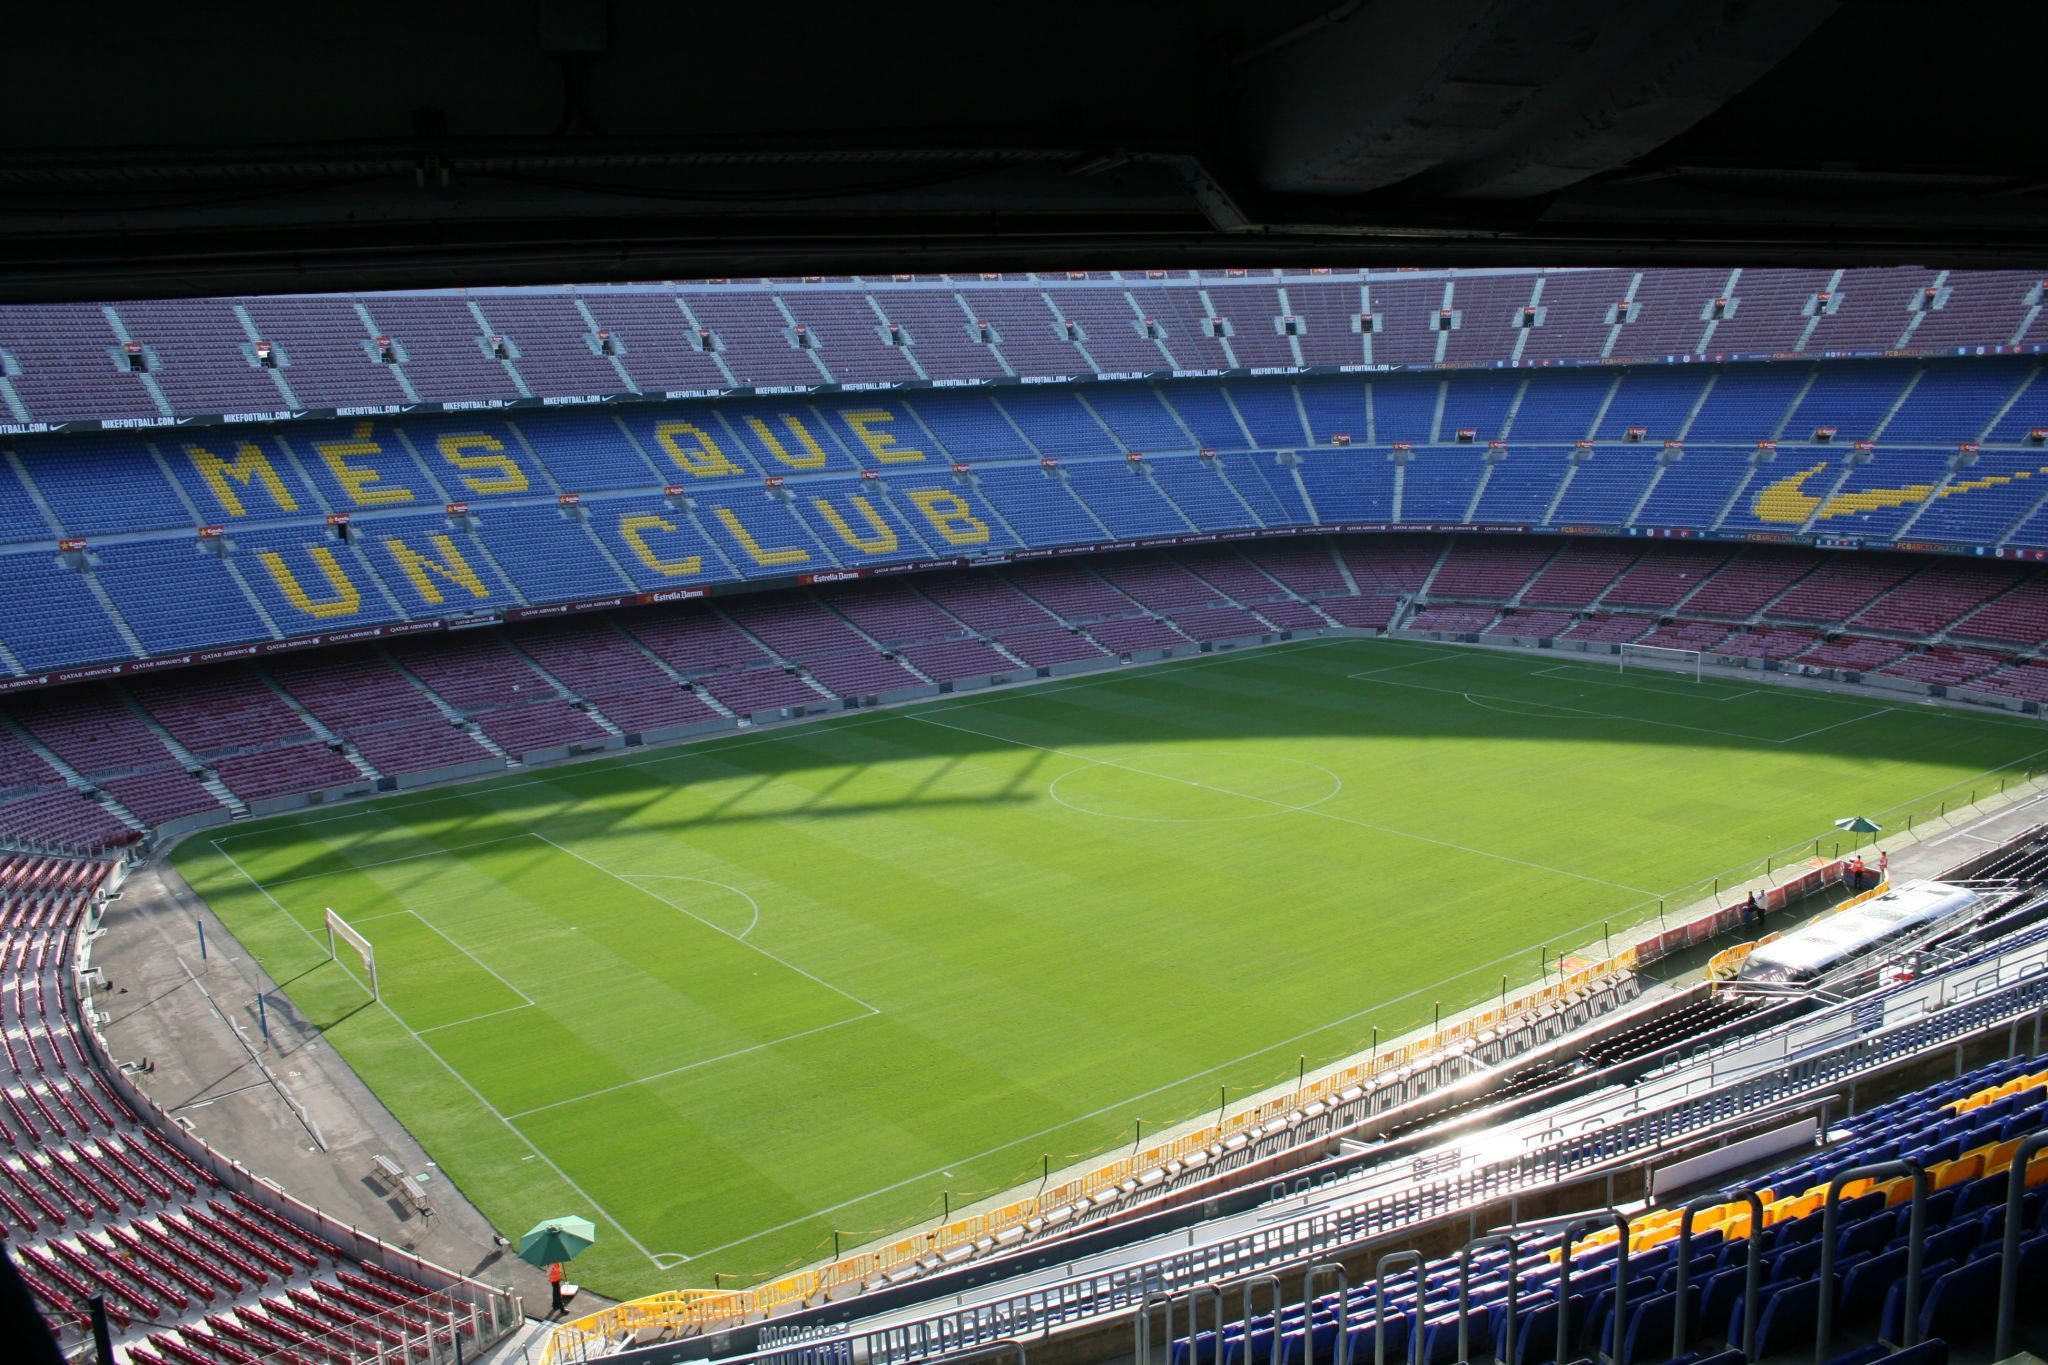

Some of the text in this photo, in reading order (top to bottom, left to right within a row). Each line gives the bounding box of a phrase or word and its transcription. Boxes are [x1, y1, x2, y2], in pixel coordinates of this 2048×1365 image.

[1172, 369, 1218, 378] NIKEFOOTBALL.COM
[1250, 366, 1299, 376] NIKEFOOTBALL.COM
[1340, 364, 1390, 373] NIKEFOOTBALL.COM
[1020, 375, 1067, 384] NIKEFOOTBALL.COM
[1097, 372, 1143, 381] NIKEFOOTBALL.COM
[841, 382, 892, 391] NIKEFOOTBALL.COM
[932, 378, 981, 388] NIKEFOOTBALL.COM
[665, 389, 719, 399] NIKEFOOTBALL.COM
[755, 385, 807, 395] NIKEFOOTBALL.COM
[442, 399, 503, 410] NIKEFOOTBALL.COM
[543, 395, 601, 406] NIKEFOOTBALL.COM
[336, 404, 400, 416] NIKEFOOTBALL.COM
[223, 410, 291, 423] NIKEFOOTBALL.COM
[101, 416, 175, 430] NIKEFOOTBALL.COM
[187, 411, 925, 517] MÉS QUE
[261, 489, 990, 619] UN CLUB
[813, 571, 860, 583] Estrella Damm
[653, 589, 704, 602] Estrella Damm
[520, 609, 538, 617] QATAR
[390, 622, 432, 633] QATAR AIRWAYS
[329, 629, 373, 642] QATAR AIRWAYS
[266, 638, 312, 651] QATAR AIRWAYS
[201, 648, 248, 661] QATAR AIRWAYS
[132, 657, 182, 670] QATAR AIRWAYS
[59, 667, 112, 681] QATAR AIRWAYS
[9, 678, 39, 688] AIRWAYS
